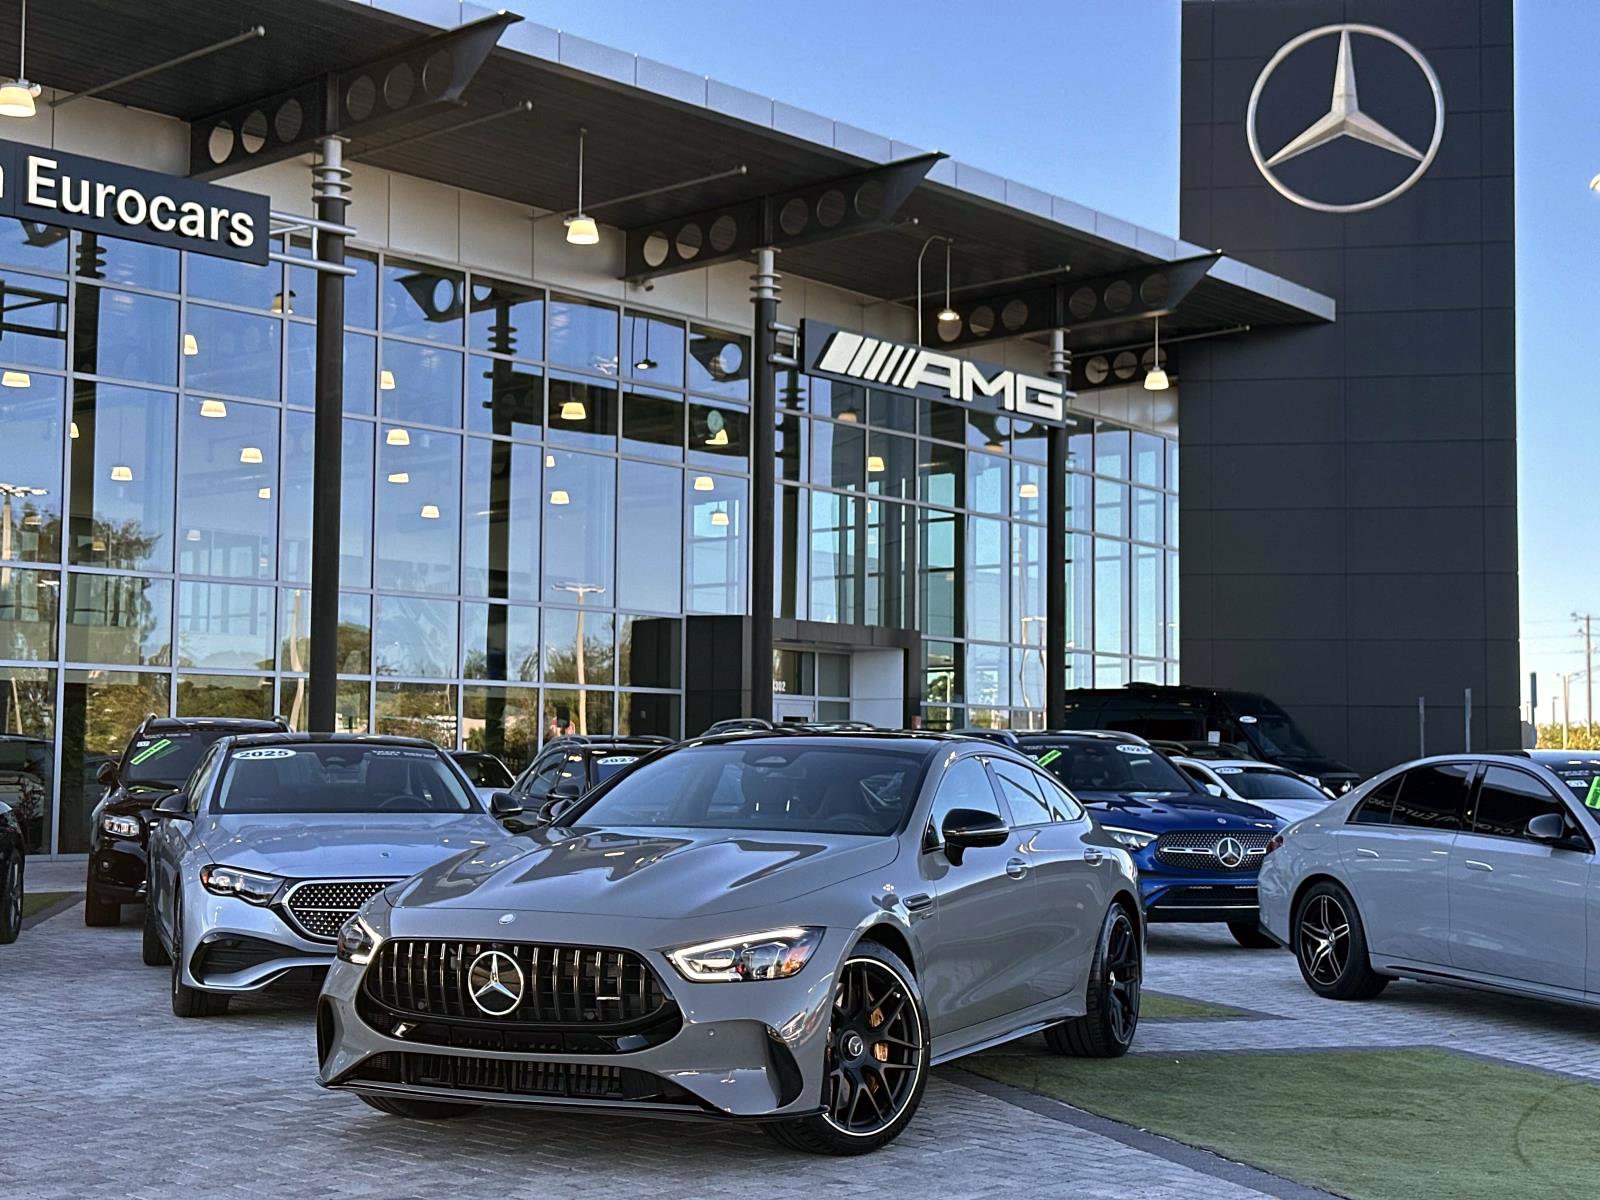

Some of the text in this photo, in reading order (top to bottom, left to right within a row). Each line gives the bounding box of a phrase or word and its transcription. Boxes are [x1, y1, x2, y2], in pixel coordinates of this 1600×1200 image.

[27, 155, 255, 248] Eurocars
[903, 350, 1063, 421] AMG
[239, 750, 289, 758] 2025
